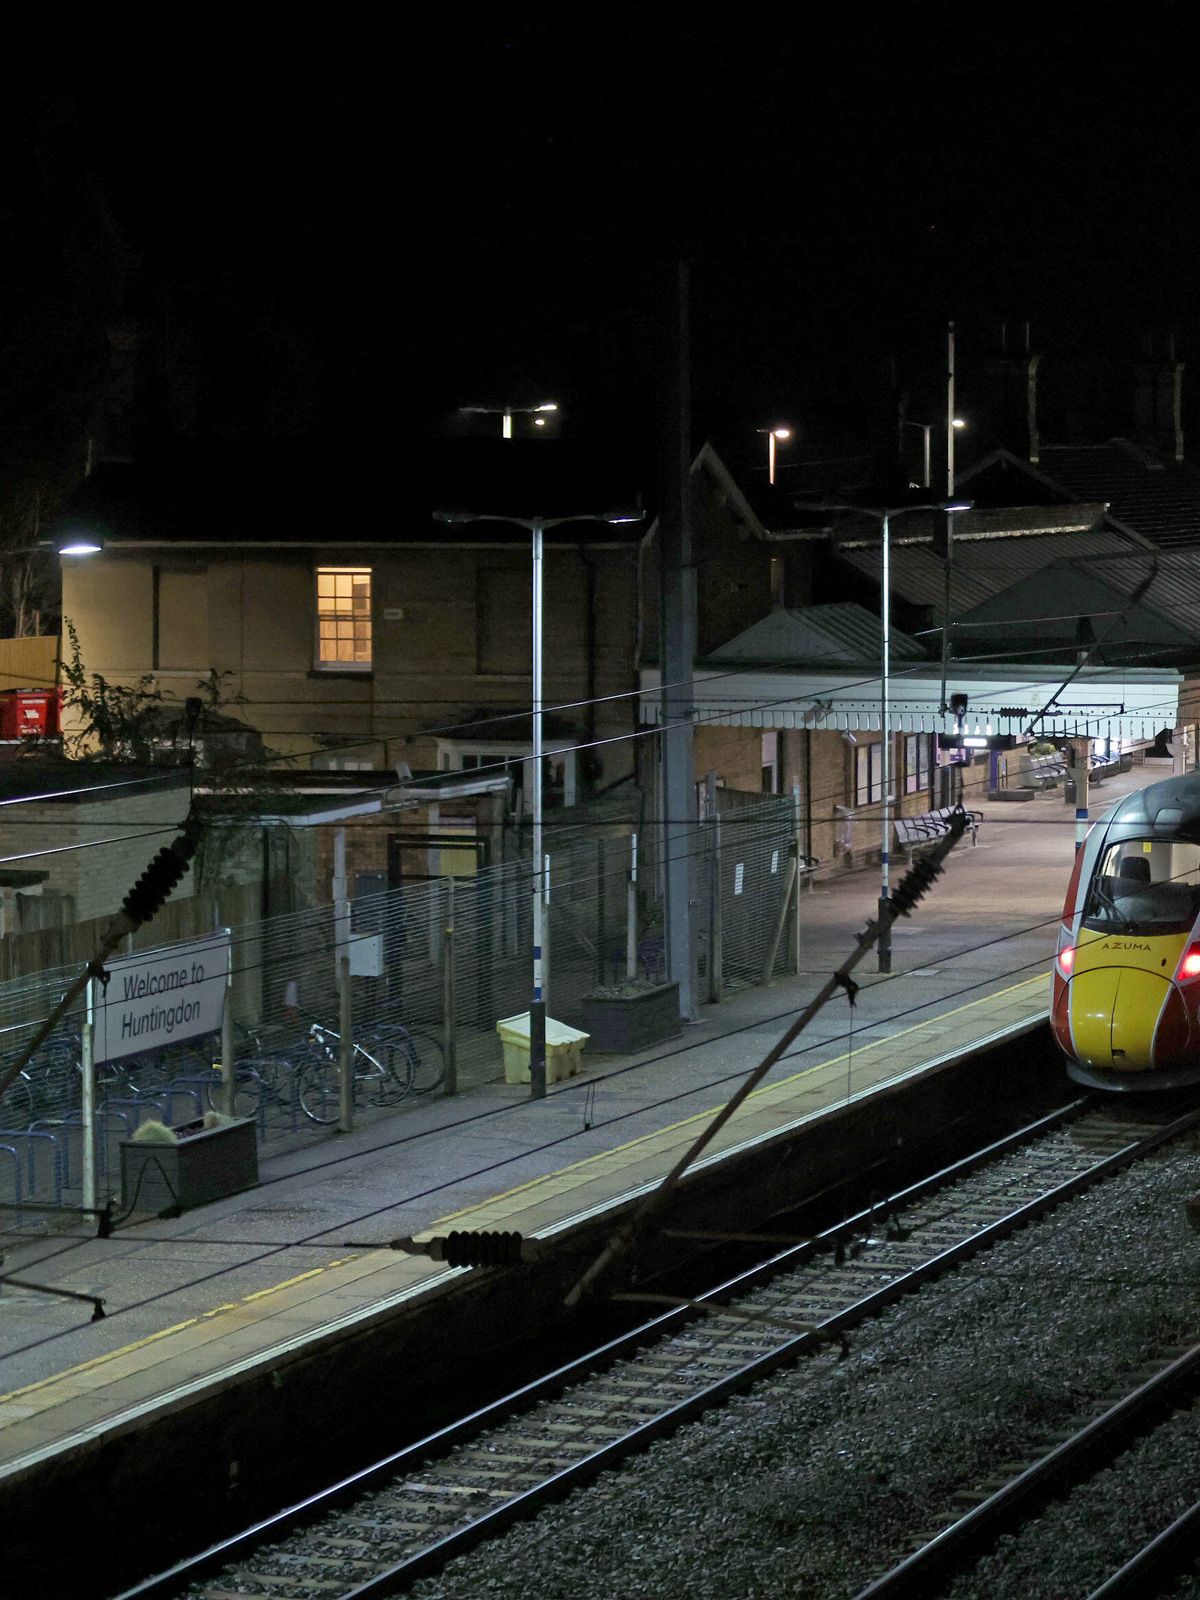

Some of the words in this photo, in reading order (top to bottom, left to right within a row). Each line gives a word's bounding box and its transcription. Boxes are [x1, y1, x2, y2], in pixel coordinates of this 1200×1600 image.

[1102, 942, 1152, 951] AZUMA
[123, 969, 188, 999] Welcome
[191, 962, 204, 983] to
[121, 999, 200, 1039] Huntingdon
